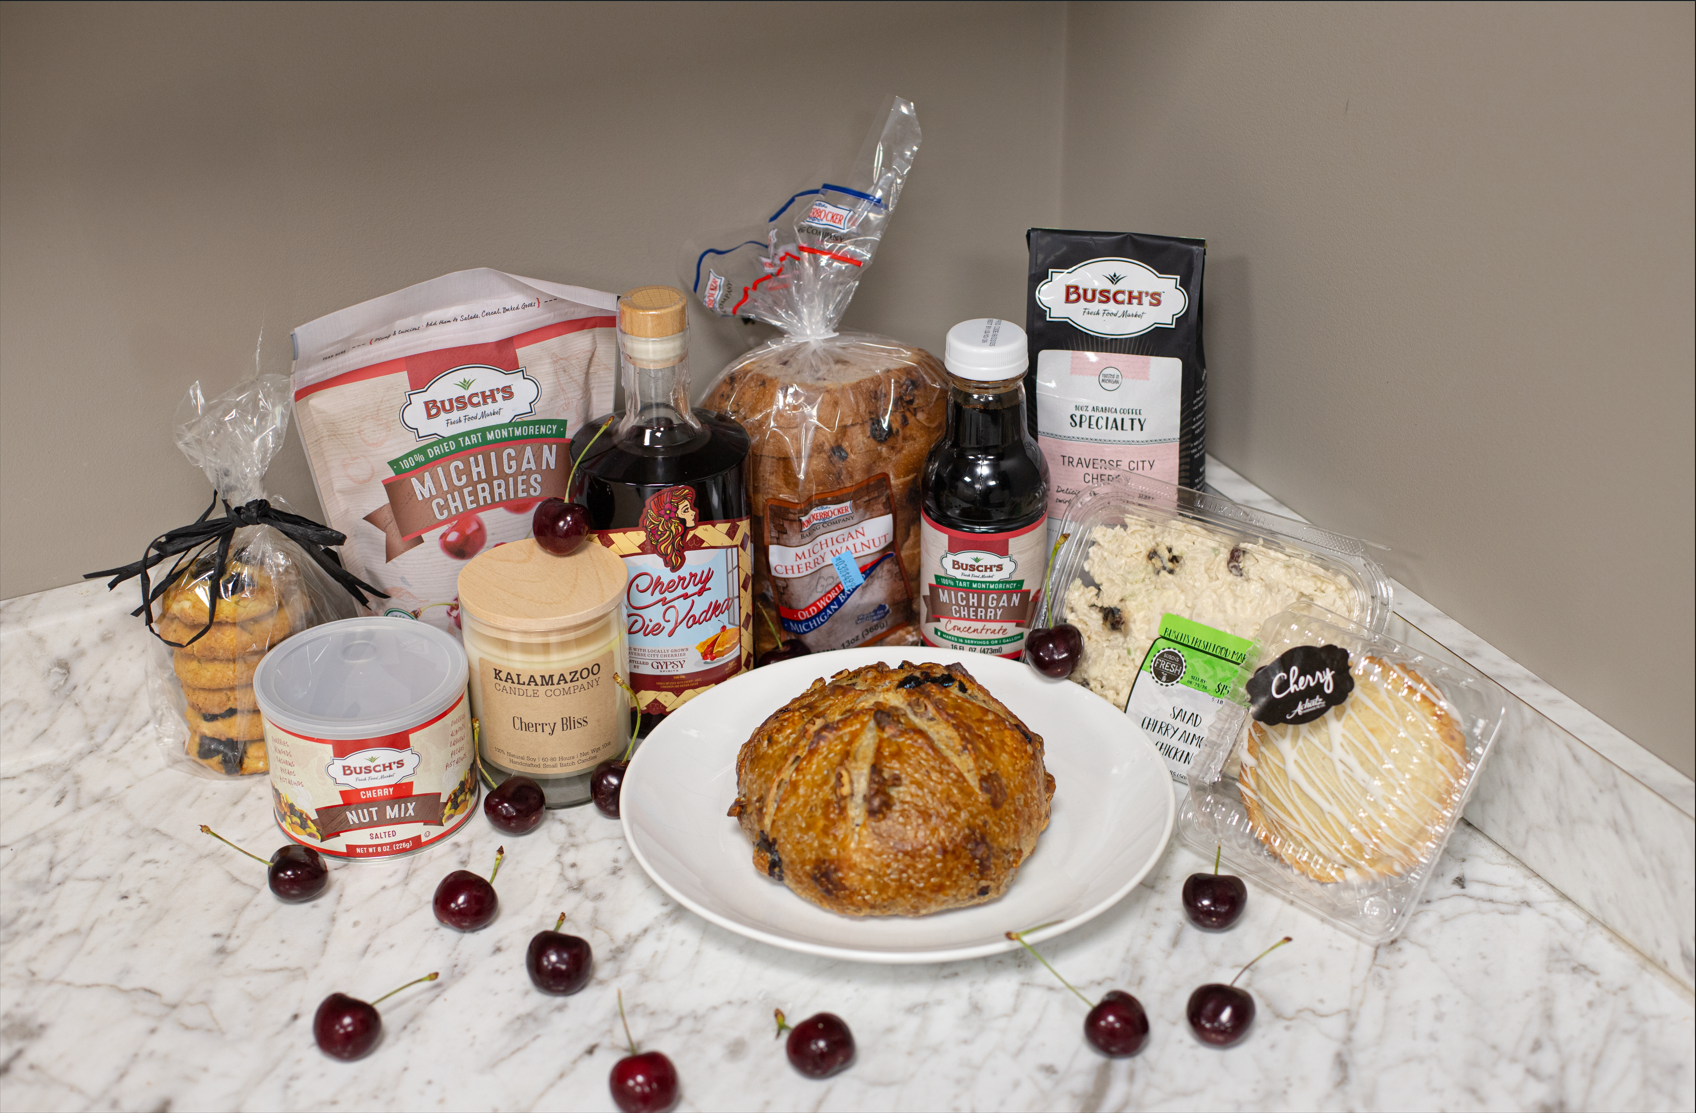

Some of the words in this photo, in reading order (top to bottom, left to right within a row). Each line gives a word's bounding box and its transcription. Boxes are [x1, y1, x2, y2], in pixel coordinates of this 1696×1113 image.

[1064, 284, 1163, 307] BUSCH'S
[502, 304, 520, 313] Baked
[521, 302, 536, 310] Goods
[1082, 307, 1100, 317] Fresh
[1101, 308, 1118, 318] Food
[1117, 309, 1146, 320] Market
[423, 385, 515, 420] BUSCH'S
[1091, 406, 1118, 414] ARABICA
[1119, 408, 1143, 416] COFFEE
[446, 418, 463, 427] Fresh
[463, 413, 478, 424] Food
[478, 408, 503, 421] Market
[1069, 413, 1146, 432] SPECIALTY
[399, 453, 425, 469] 100%
[427, 440, 456, 458] DRIED
[458, 433, 482, 447] TART
[486, 424, 558, 441] MONTMORENCY
[411, 444, 557, 501] MICHIGAN
[1061, 455, 1122, 470] TRAVERSE
[1128, 460, 1155, 471] CITY
[431, 474, 542, 520] CHERRIES
[801, 525, 820, 539] BAKING
[822, 515, 854, 528] COMPANY
[802, 506, 849, 529] KNICKERBOCKER
[774, 552, 827, 575] CHERRY
[830, 533, 889, 557] WALNUT
[794, 527, 866, 562] MICHIGAN
[952, 559, 1003, 572] BUSCH'S
[627, 567, 714, 610] Cherry
[939, 588, 1020, 607] MICHIGAN
[663, 597, 734, 637] Vodka
[789, 604, 839, 633] MICHIGAN
[798, 606, 817, 620] OLD
[952, 605, 1003, 620] CHERRY
[841, 635, 859, 649] 13oz
[862, 621, 888, 638] (368g)
[945, 620, 1008, 635] Concentrate
[1003, 635, 1021, 643] GALLON
[1164, 627, 1191, 645] BUSCH'S
[1191, 636, 1212, 650] FRESH
[1212, 643, 1231, 658] FOOD
[980, 646, 1002, 654] (473ml)
[493, 663, 601, 687] KALAMAZOO
[651, 660, 685, 669] GYPSY
[1154, 658, 1182, 675] FRESH
[494, 683, 540, 698] CANDLE
[544, 677, 601, 698] COMPANY
[1271, 665, 1336, 699] Cherry
[512, 715, 557, 736] Cherry
[561, 715, 588, 732] Bliss
[1170, 706, 1202, 727] SALAD
[1141, 716, 1179, 739] CHERRY
[494, 747, 505, 755] 100%
[507, 752, 525, 760] Natural
[509, 758, 540, 768] Handcrafted
[577, 755, 597, 764] Candles
[342, 759, 404, 776] BUSCH'S
[360, 787, 394, 798] CHERRY
[346, 807, 378, 824] NUT
[386, 802, 416, 819] MIX
[369, 830, 396, 840] SALTED
